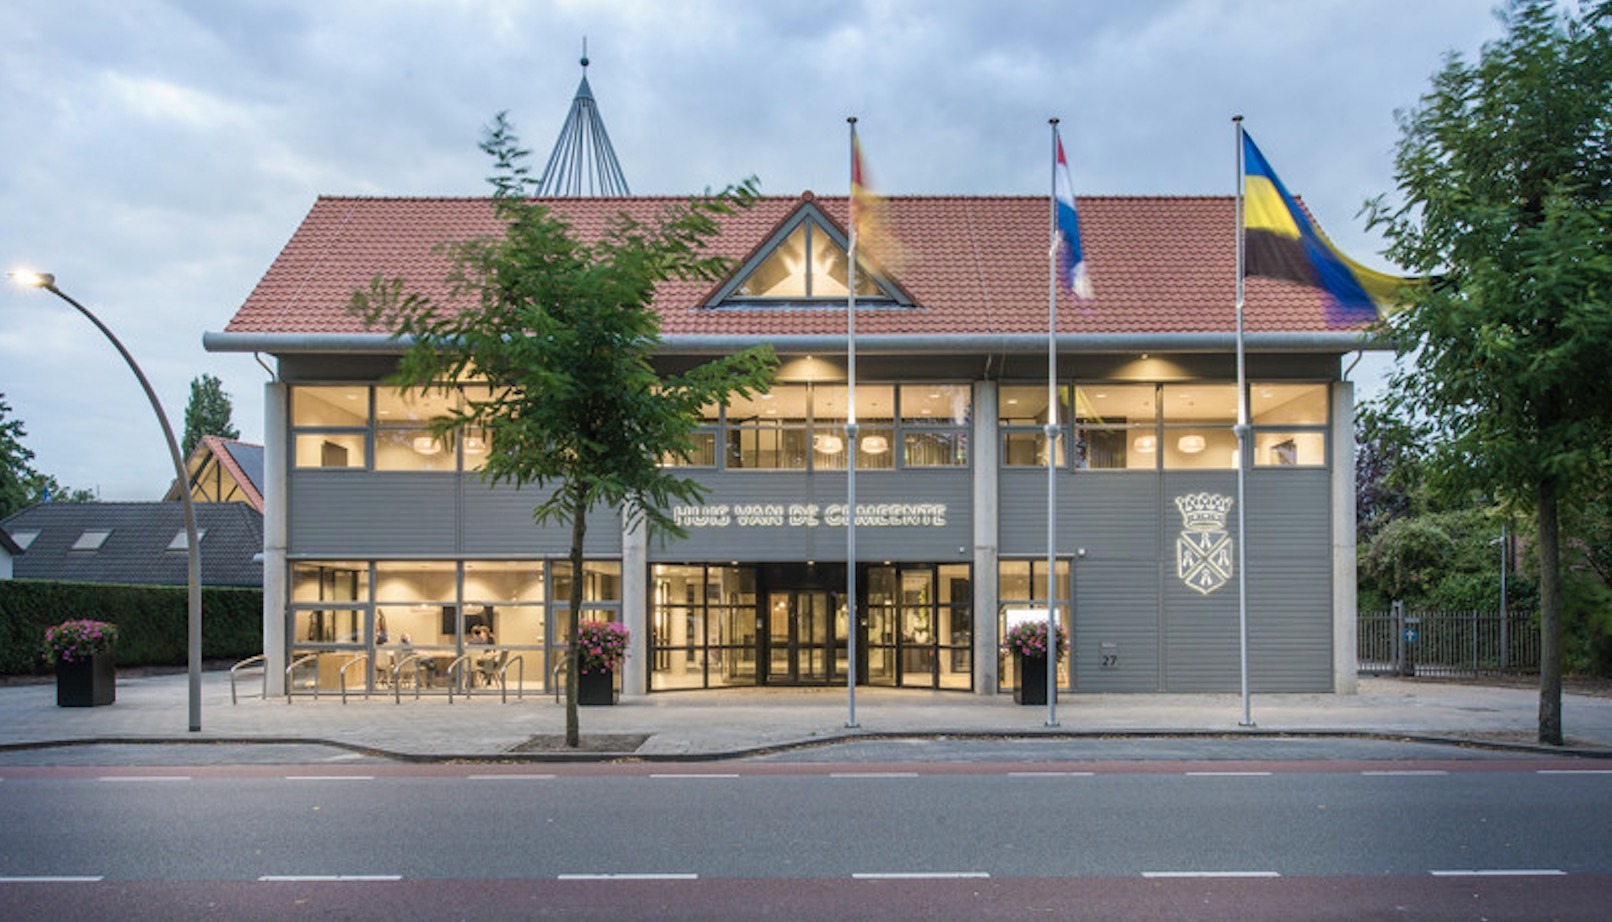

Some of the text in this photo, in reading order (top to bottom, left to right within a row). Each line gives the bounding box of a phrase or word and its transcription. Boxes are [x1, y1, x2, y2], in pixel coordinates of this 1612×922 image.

[673, 505, 730, 526] HUIS
[734, 504, 784, 526] VAN
[788, 504, 819, 526] DE
[1102, 655, 1117, 666] 27
